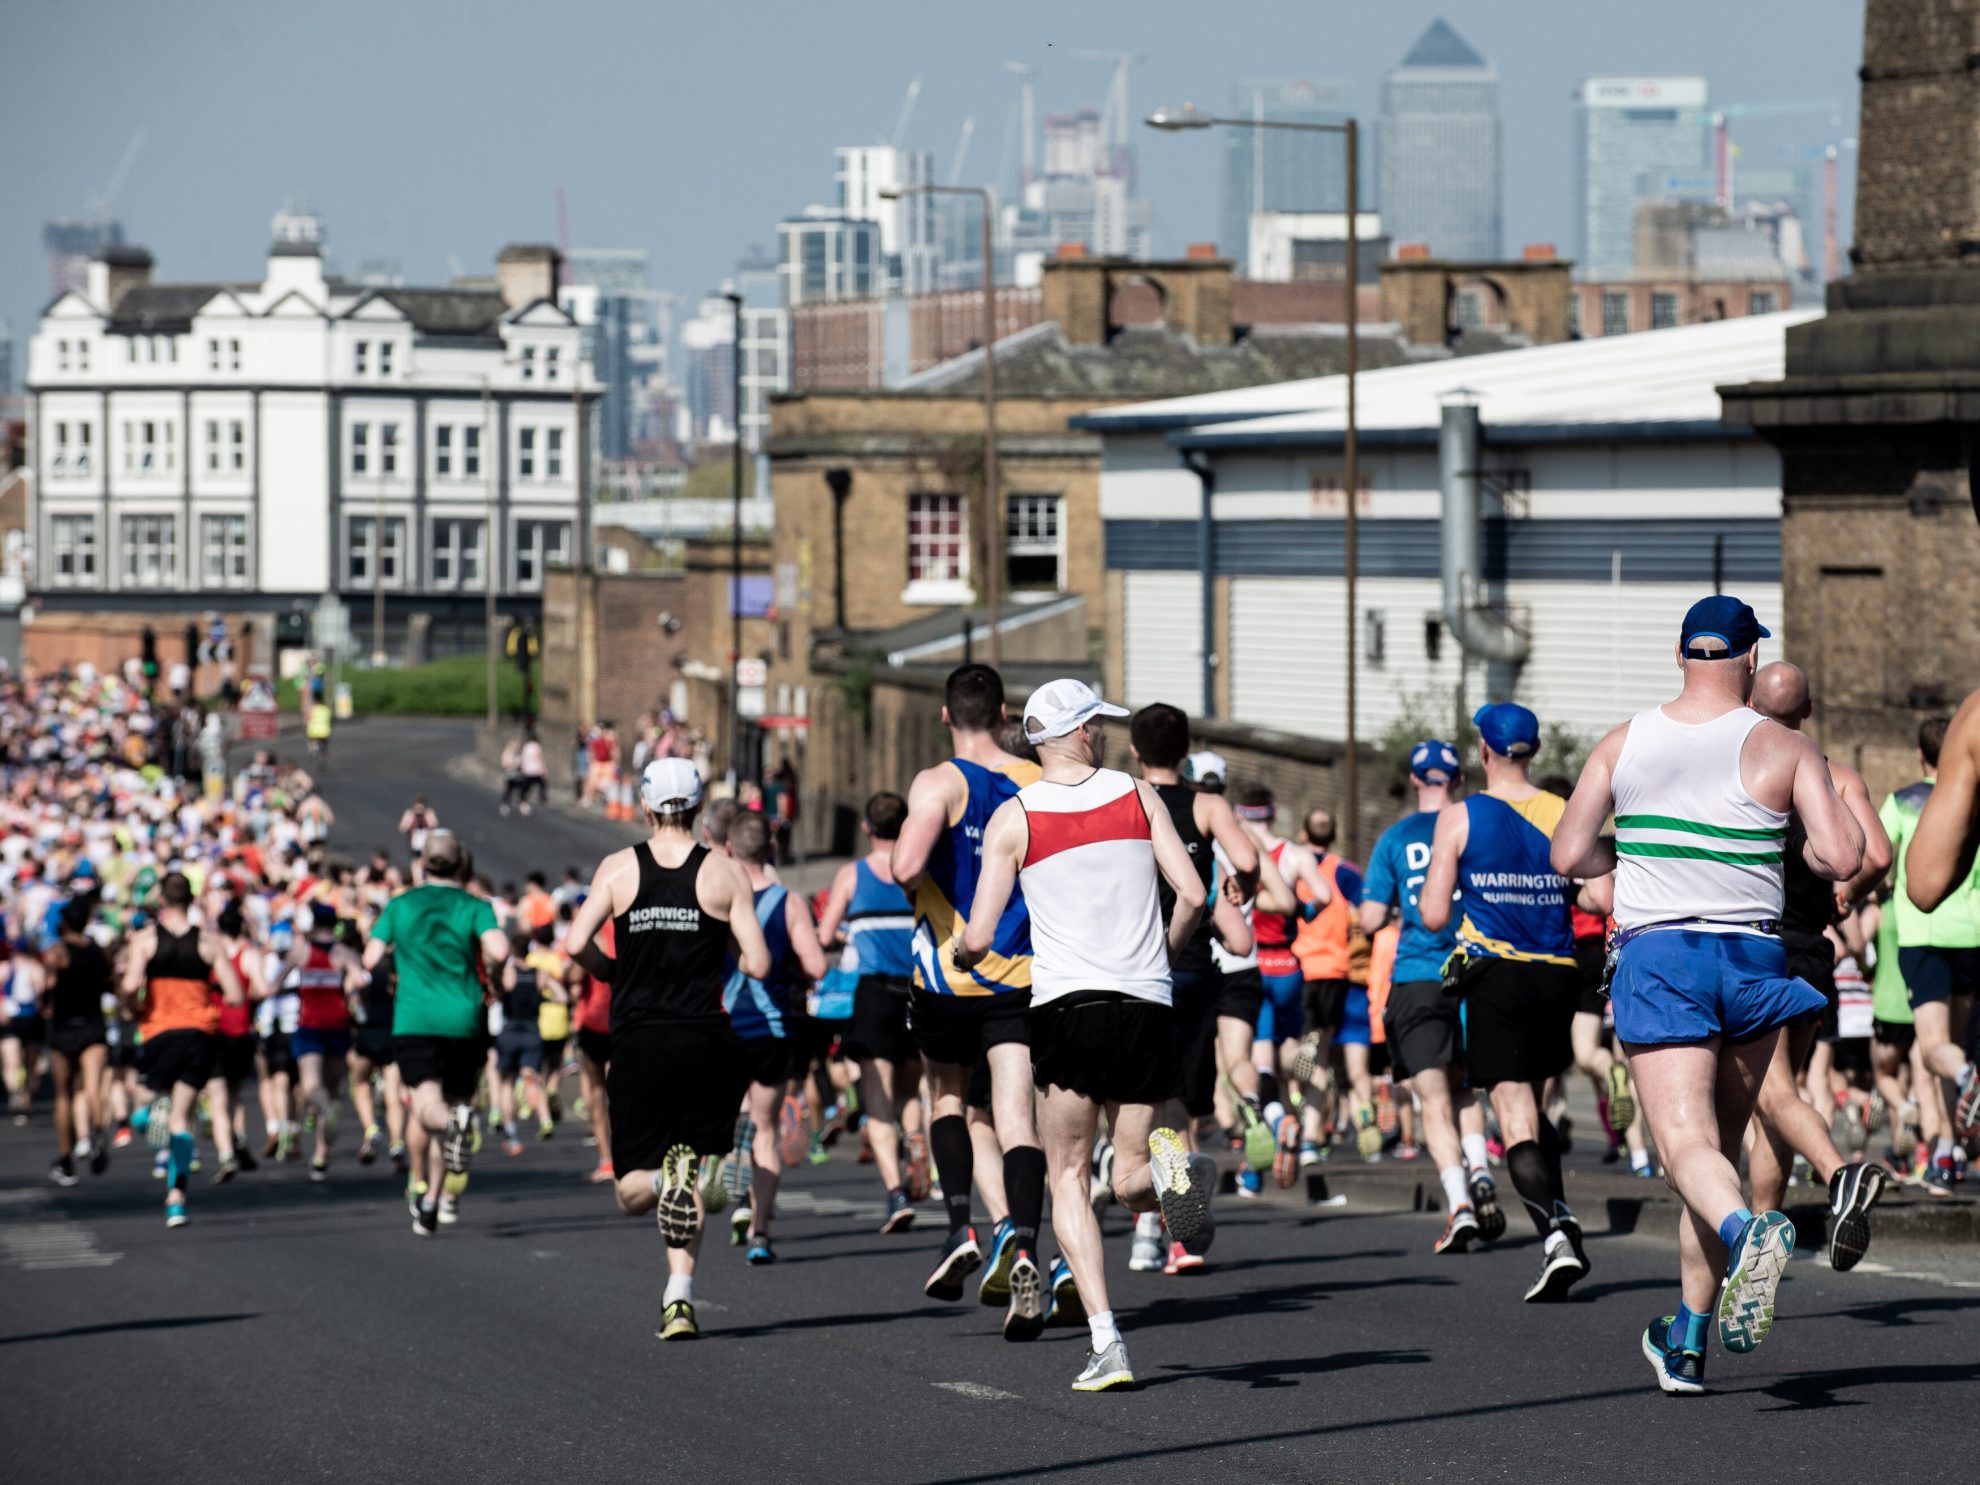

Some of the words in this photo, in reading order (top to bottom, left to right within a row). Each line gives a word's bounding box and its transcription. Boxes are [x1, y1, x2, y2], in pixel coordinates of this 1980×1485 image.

[1470, 872, 1571, 889] WARRINGTON
[1482, 891, 1536, 906] RUNNING
[629, 906, 700, 924] NORWICH
